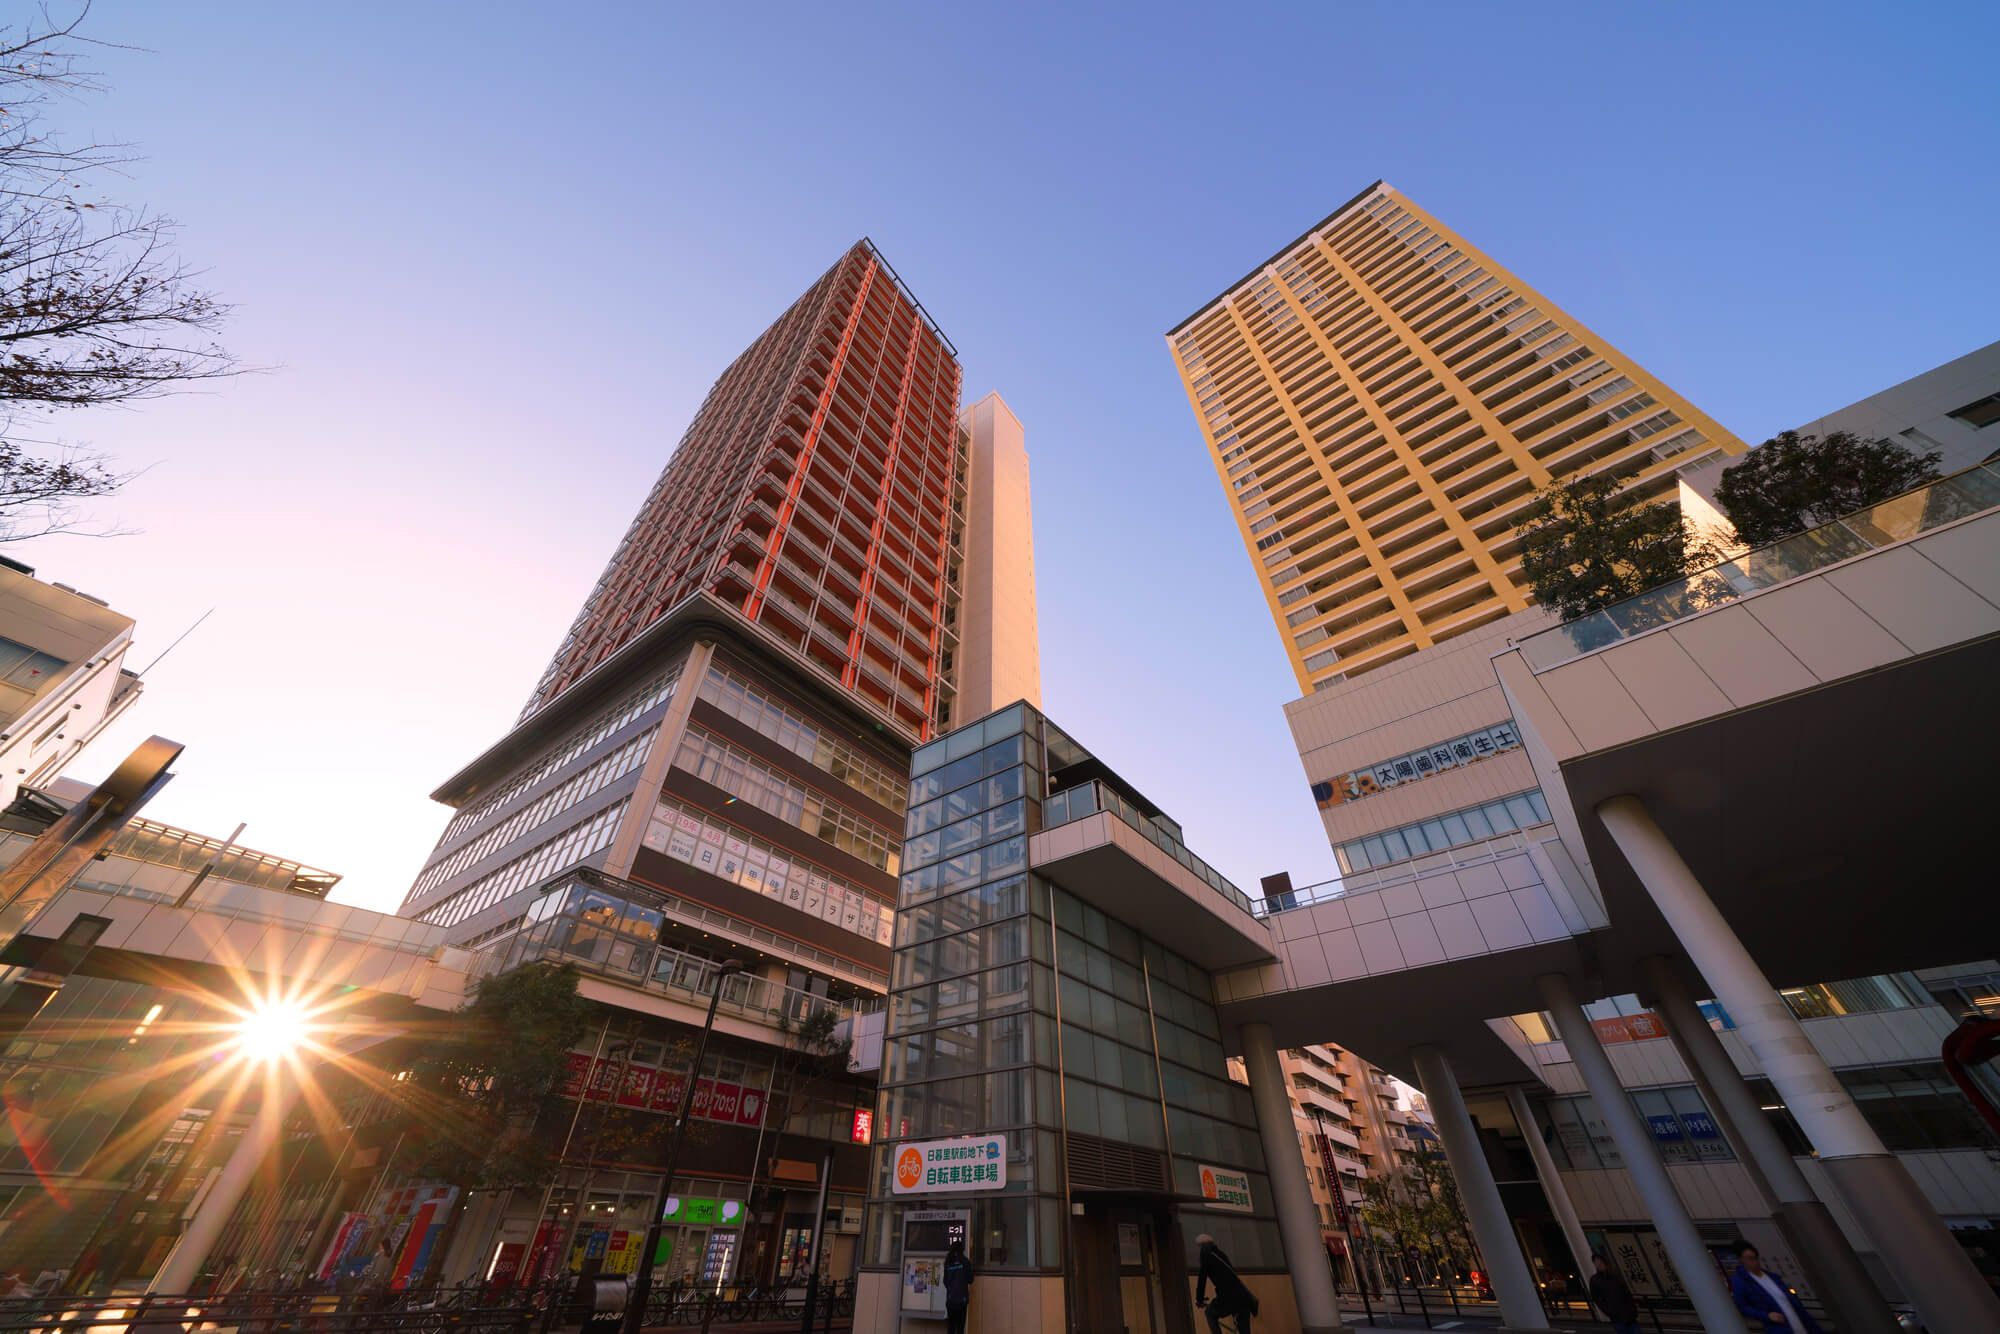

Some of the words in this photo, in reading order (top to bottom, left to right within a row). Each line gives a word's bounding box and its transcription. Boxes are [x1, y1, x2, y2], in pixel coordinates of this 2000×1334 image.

[1377, 727, 1516, 784] 太陽歯科衛生士
[927, 1145, 985, 1162] 日暮里駅前地下
[926, 1163, 998, 1186] 自転車駐車場
